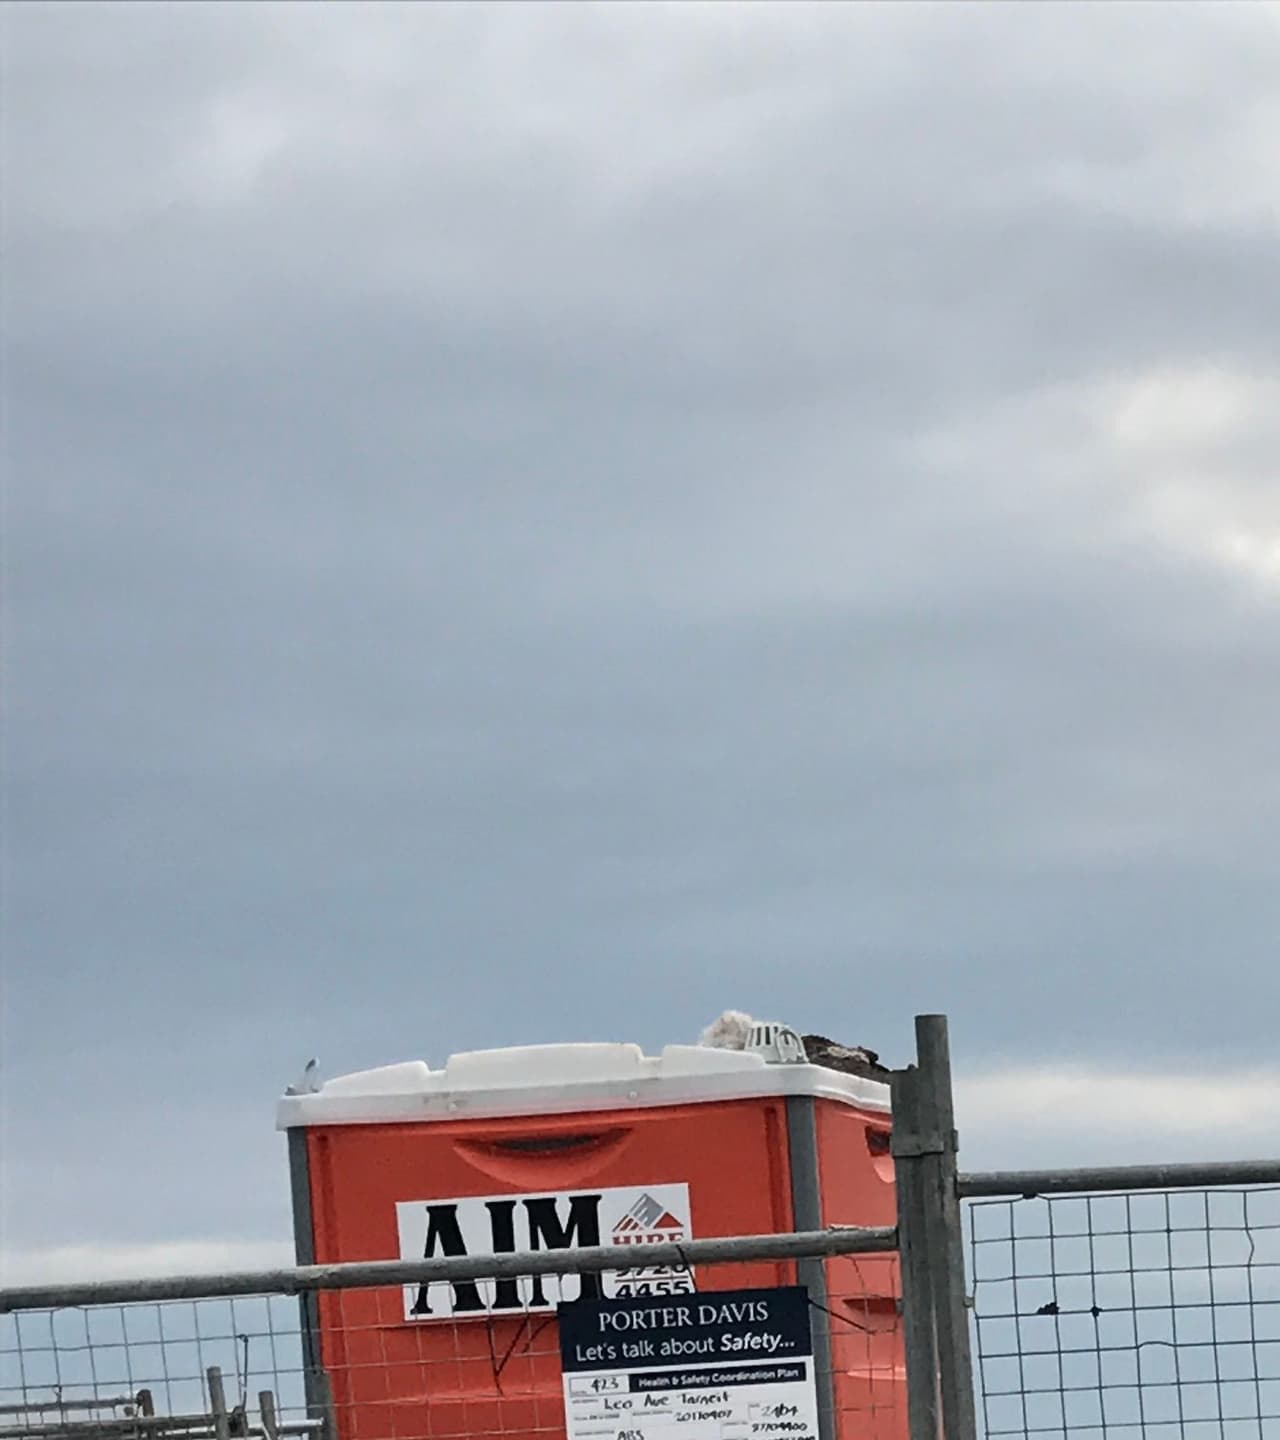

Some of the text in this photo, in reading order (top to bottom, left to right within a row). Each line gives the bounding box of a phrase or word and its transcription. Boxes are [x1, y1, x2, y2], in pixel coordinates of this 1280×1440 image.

[409, 1194, 602, 1315] AIM
[615, 1280, 690, 1298] 4455
[599, 1301, 769, 1332] PORTER DAVIS
[575, 1333, 795, 1362] Let's talk about Safety...
[638, 1377, 670, 1388] Health
[681, 1374, 711, 1385] Safety
[711, 1371, 775, 1383] Coordination
[777, 1368, 799, 1379] Plan
